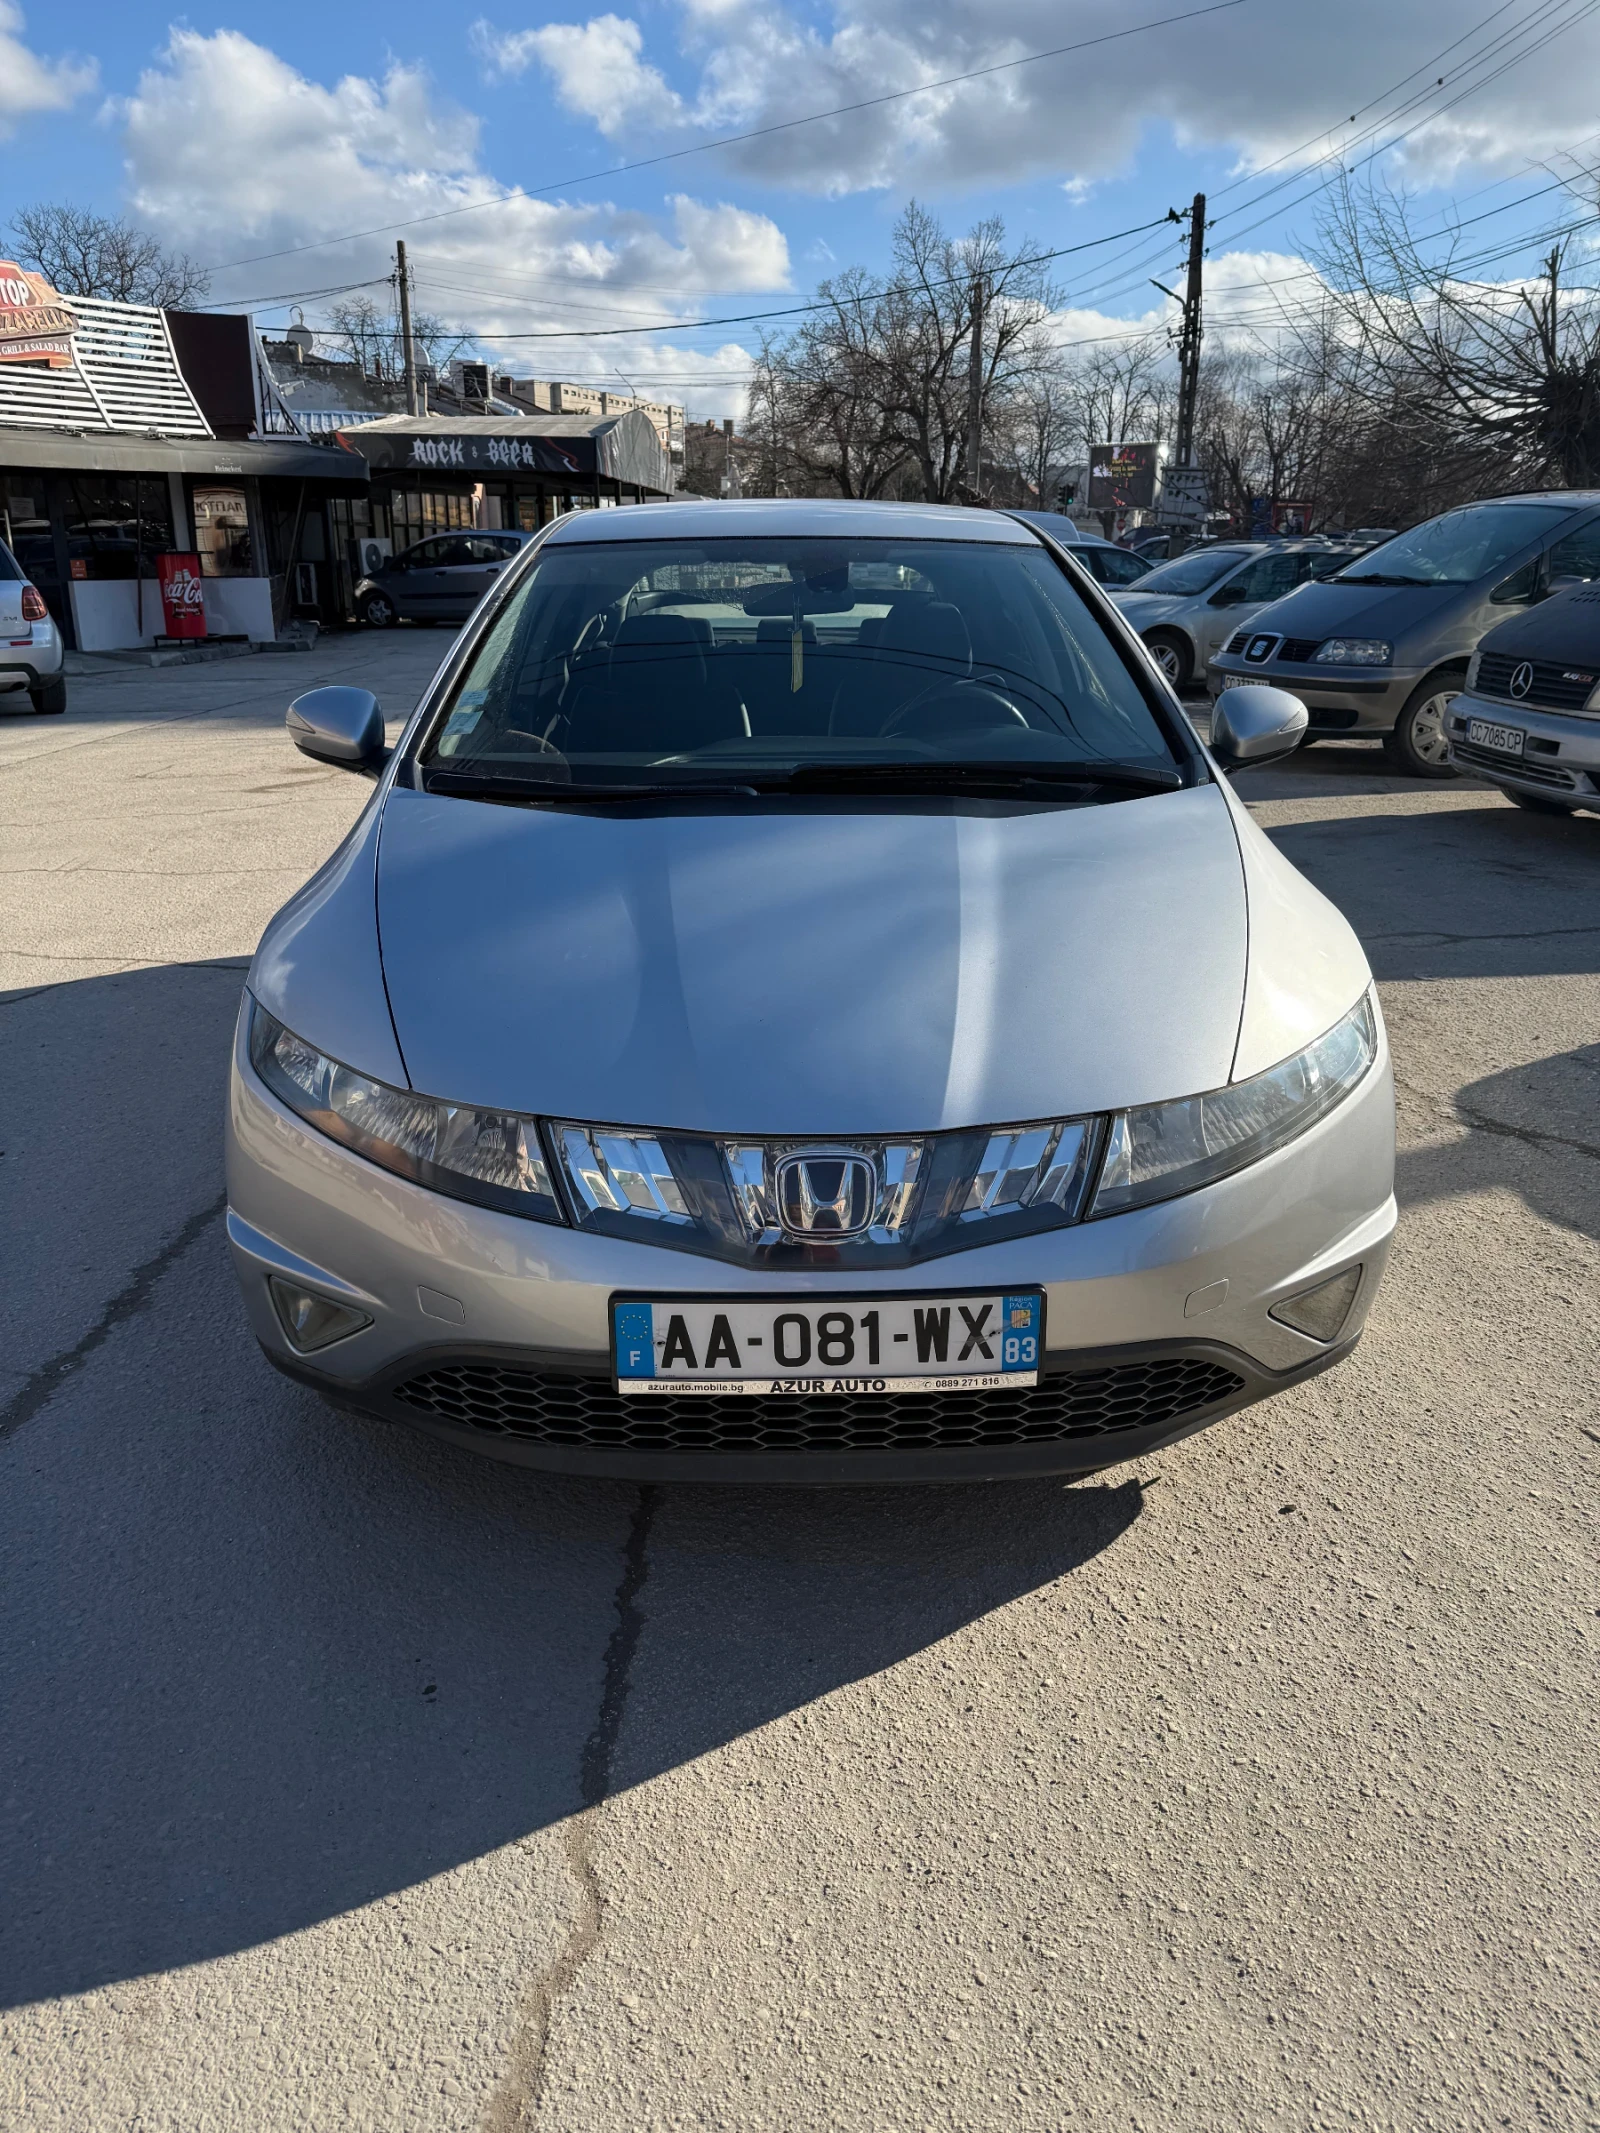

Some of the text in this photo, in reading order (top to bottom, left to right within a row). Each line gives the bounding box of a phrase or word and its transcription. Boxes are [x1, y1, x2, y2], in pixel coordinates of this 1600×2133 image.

[2, 342, 70, 355] GRILL & SALAD BAR
[408, 437, 465, 467] ROCK
[661, 1304, 995, 1369] AA-081-WX
[630, 1351, 641, 1366] F
[1005, 1337, 1036, 1363] 83
[648, 1377, 1000, 1393] azurauto.mobile.bg AZUR AUTO 0889 271 816
